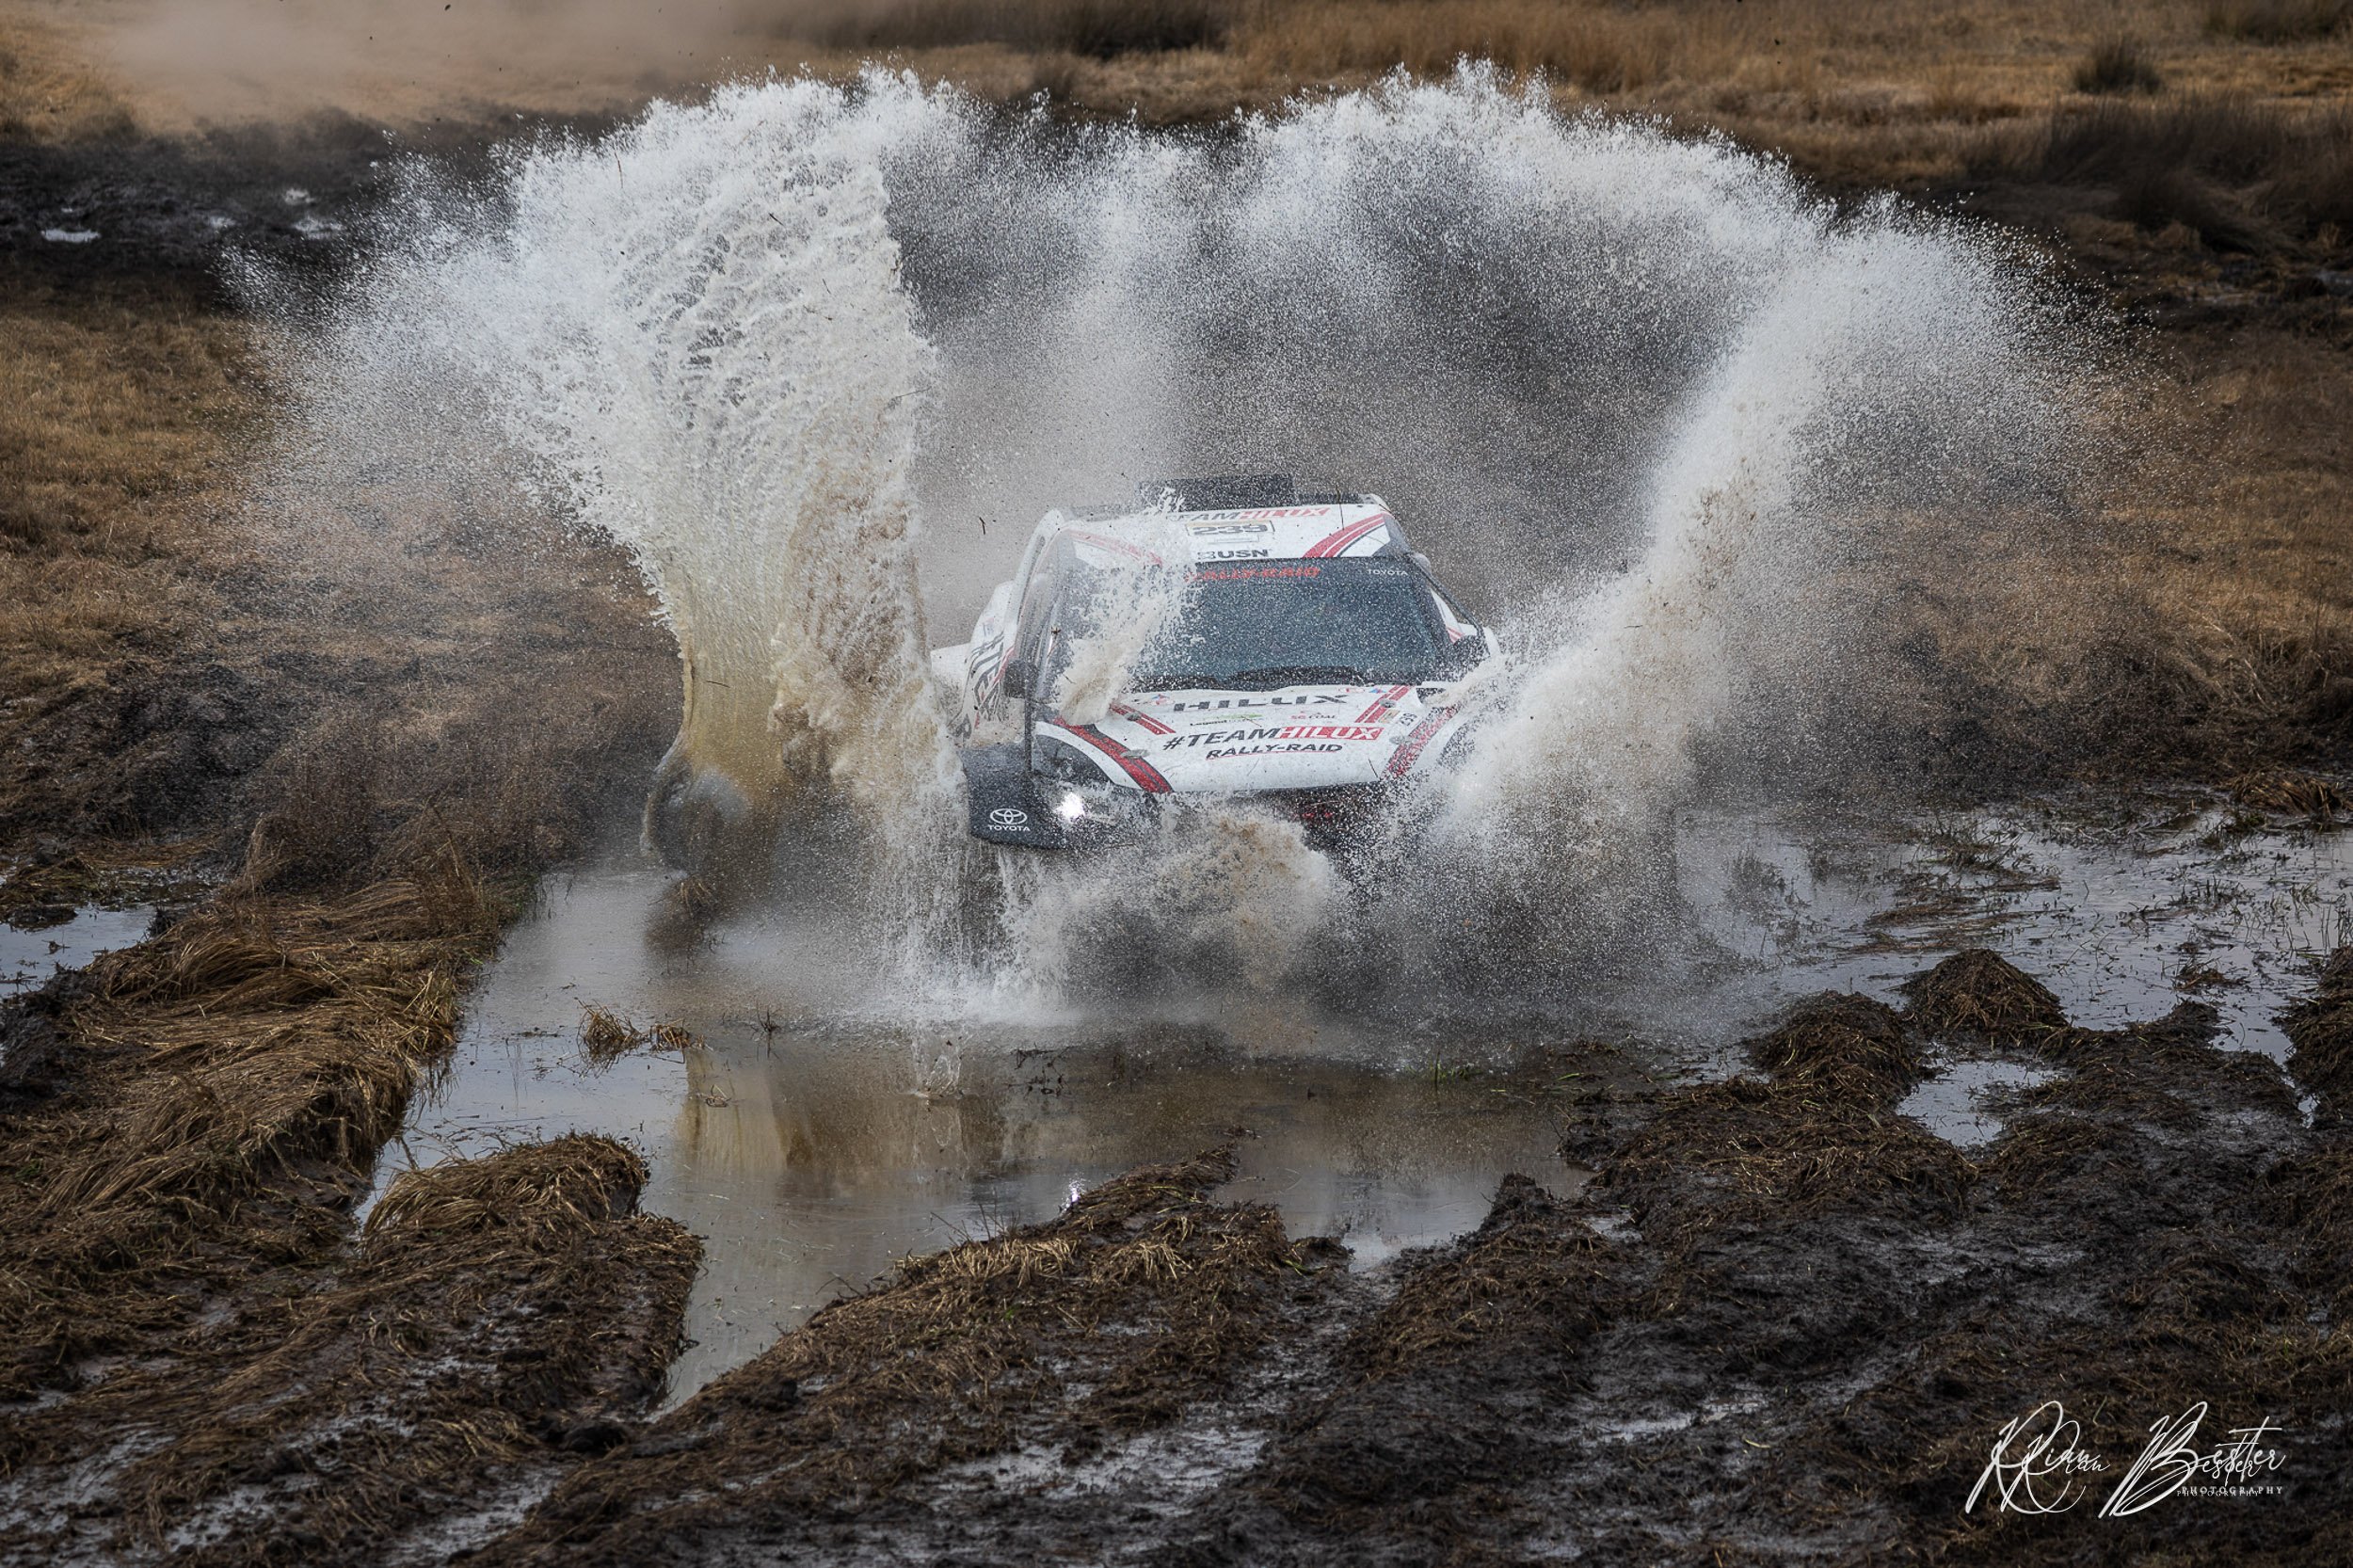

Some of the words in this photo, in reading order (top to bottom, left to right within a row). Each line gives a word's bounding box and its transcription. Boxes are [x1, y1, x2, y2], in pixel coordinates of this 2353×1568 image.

[1217, 549, 1269, 559] USN
[1173, 694, 1349, 712] HILUX
[1162, 725, 1385, 751] #TEAMHILUX
[1206, 744, 1343, 760] RALLY-RAID
[987, 824, 1032, 832] TOYOTA
